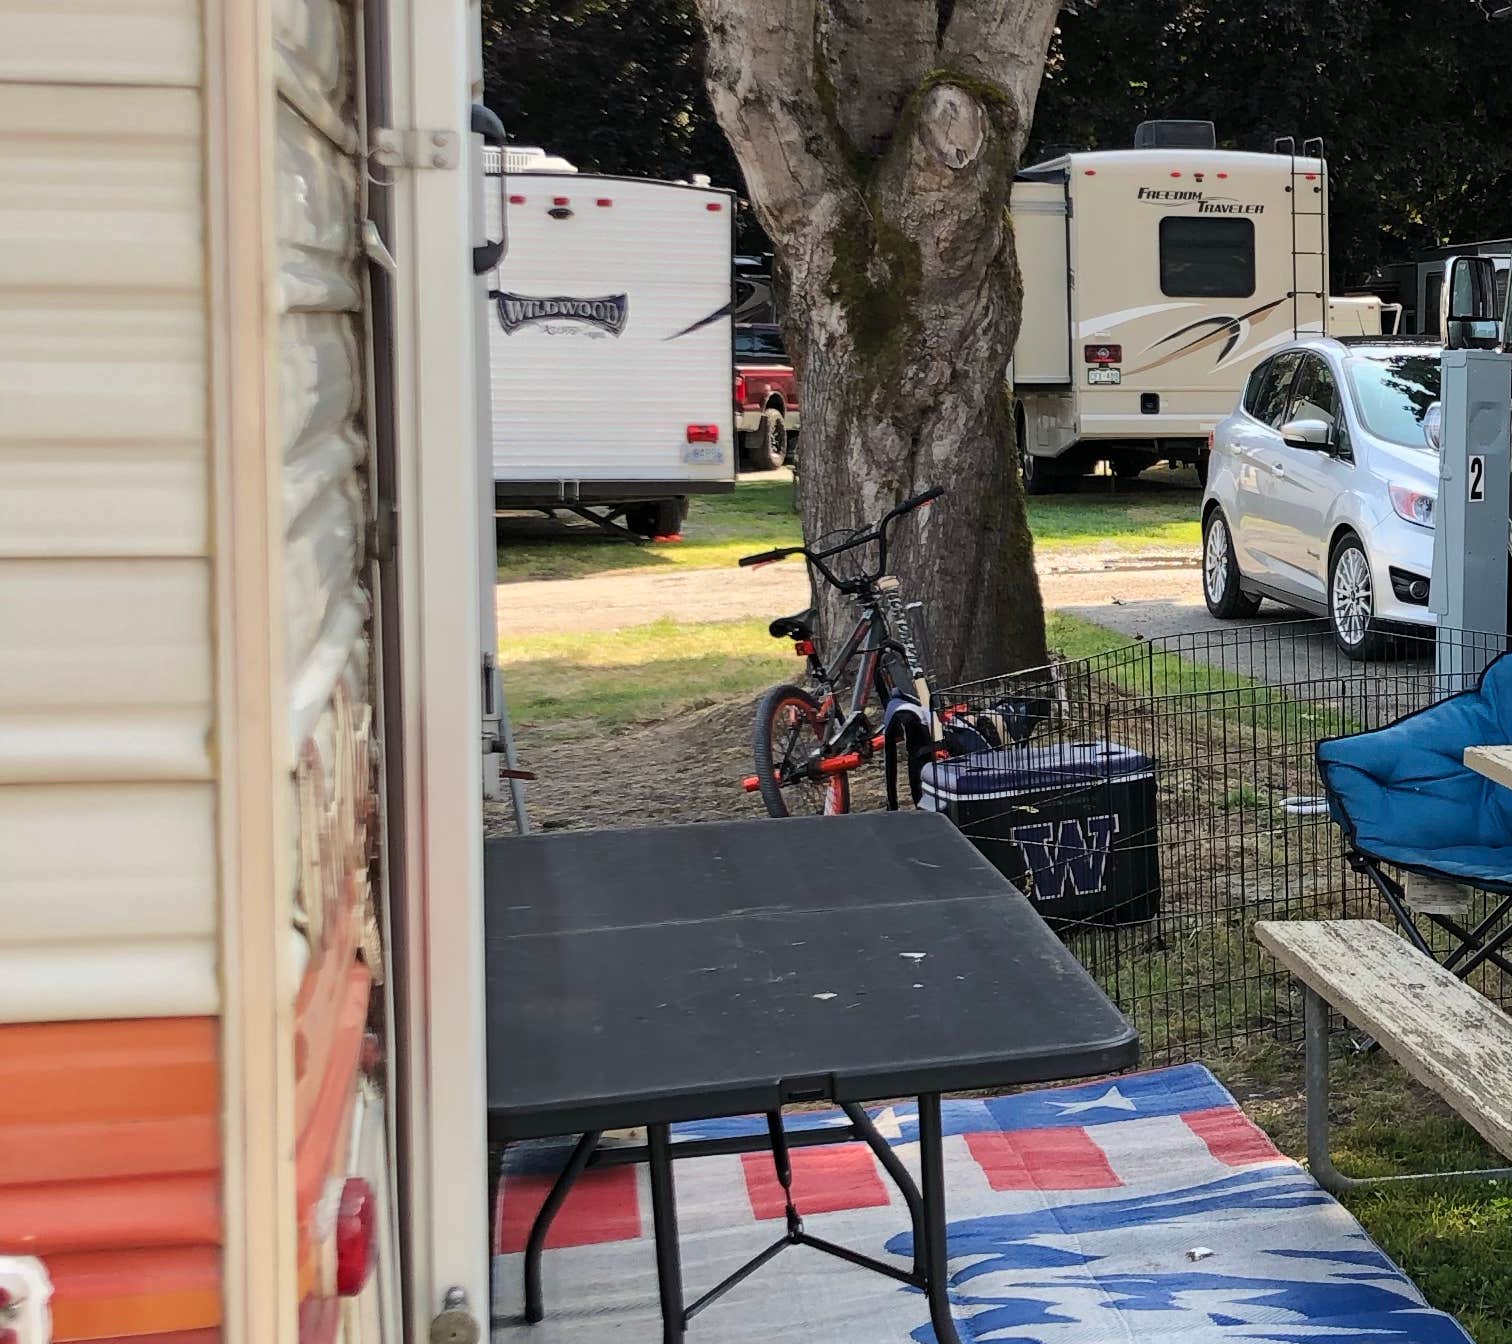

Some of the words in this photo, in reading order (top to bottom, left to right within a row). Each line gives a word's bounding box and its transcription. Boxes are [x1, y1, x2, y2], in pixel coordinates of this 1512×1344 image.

[1137, 187, 1203, 200] FREEDOM
[1197, 200, 1265, 214] TRAVELER
[504, 300, 619, 324] WILDWOOD
[1471, 457, 1483, 500] 2
[1010, 814, 1120, 900] W
